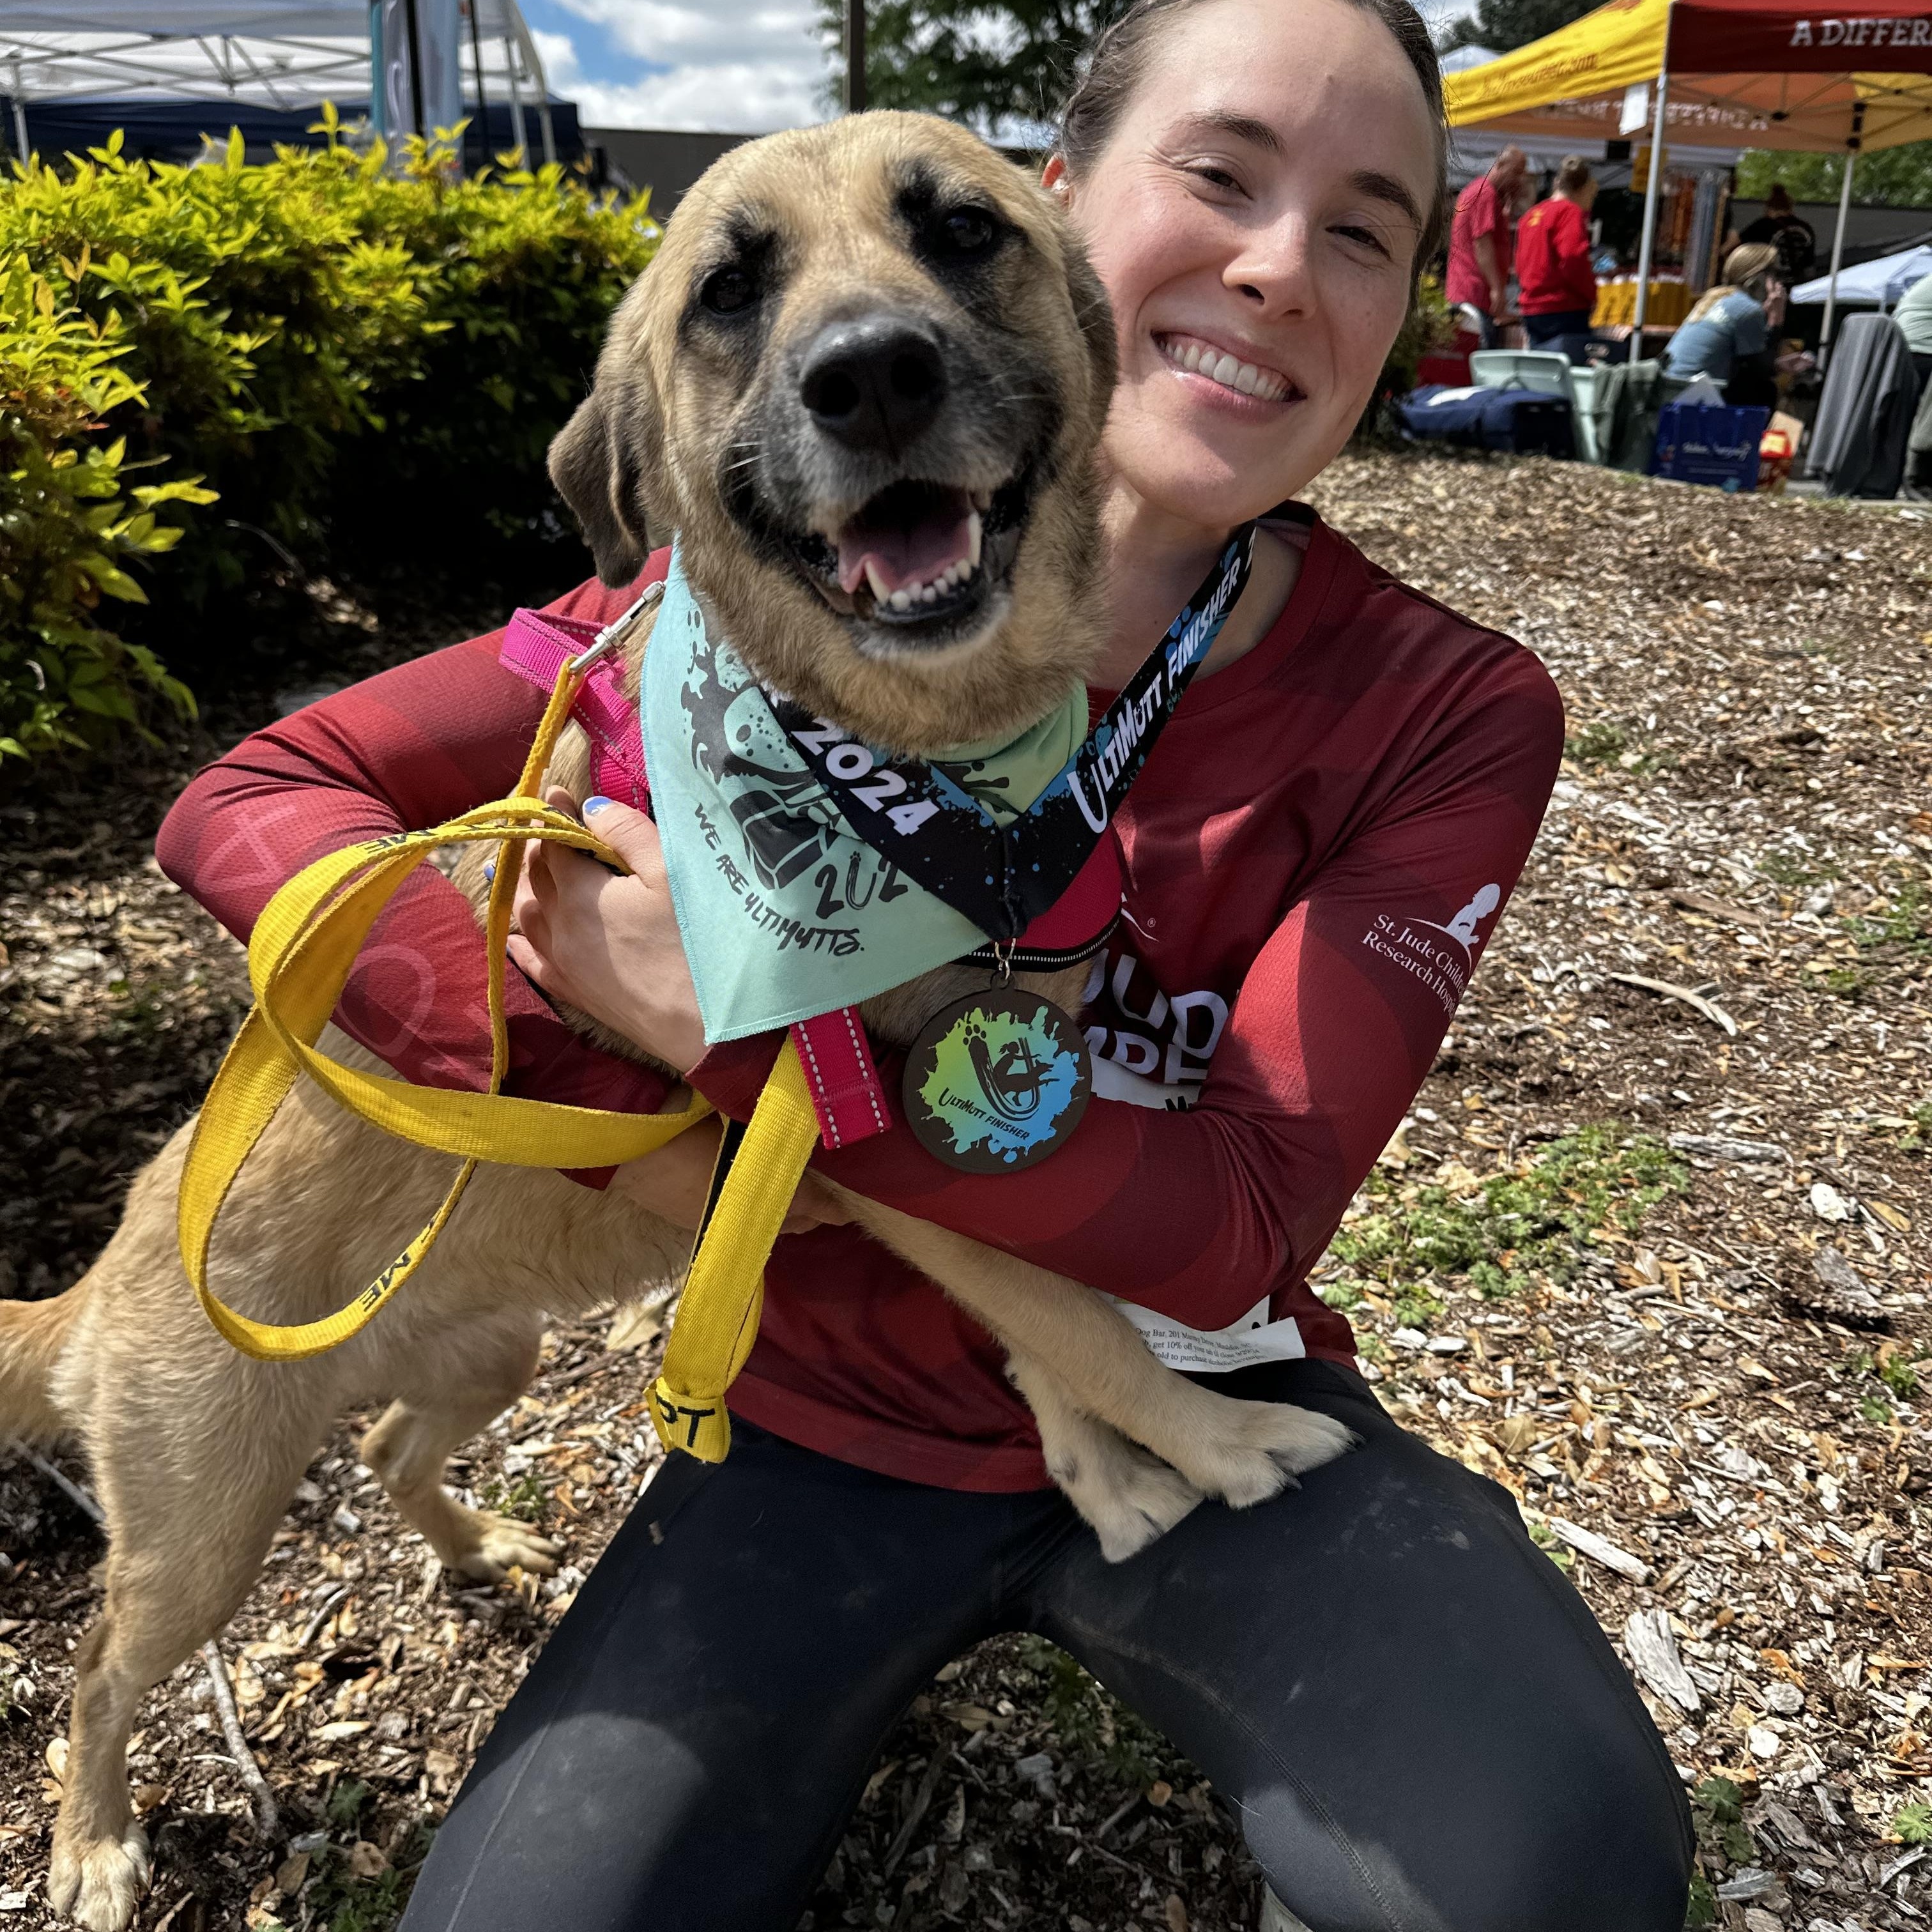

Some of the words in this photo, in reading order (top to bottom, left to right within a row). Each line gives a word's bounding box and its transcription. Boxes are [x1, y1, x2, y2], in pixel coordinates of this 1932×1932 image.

[1790, 19, 1814, 47] A
[1167, 556, 1241, 691] FINISHER
[791, 716, 940, 836] 2024
[694, 801, 722, 850] WE
[716, 854, 750, 895] ARE
[1361, 930, 1434, 985] Research
[1373, 914, 1396, 937] St.
[1394, 926, 1436, 959] Jude
[985, 1116, 1031, 1140] FINISHER
[1169, 1330, 1180, 1338] 201
[1180, 1354, 1208, 1363] purchase
